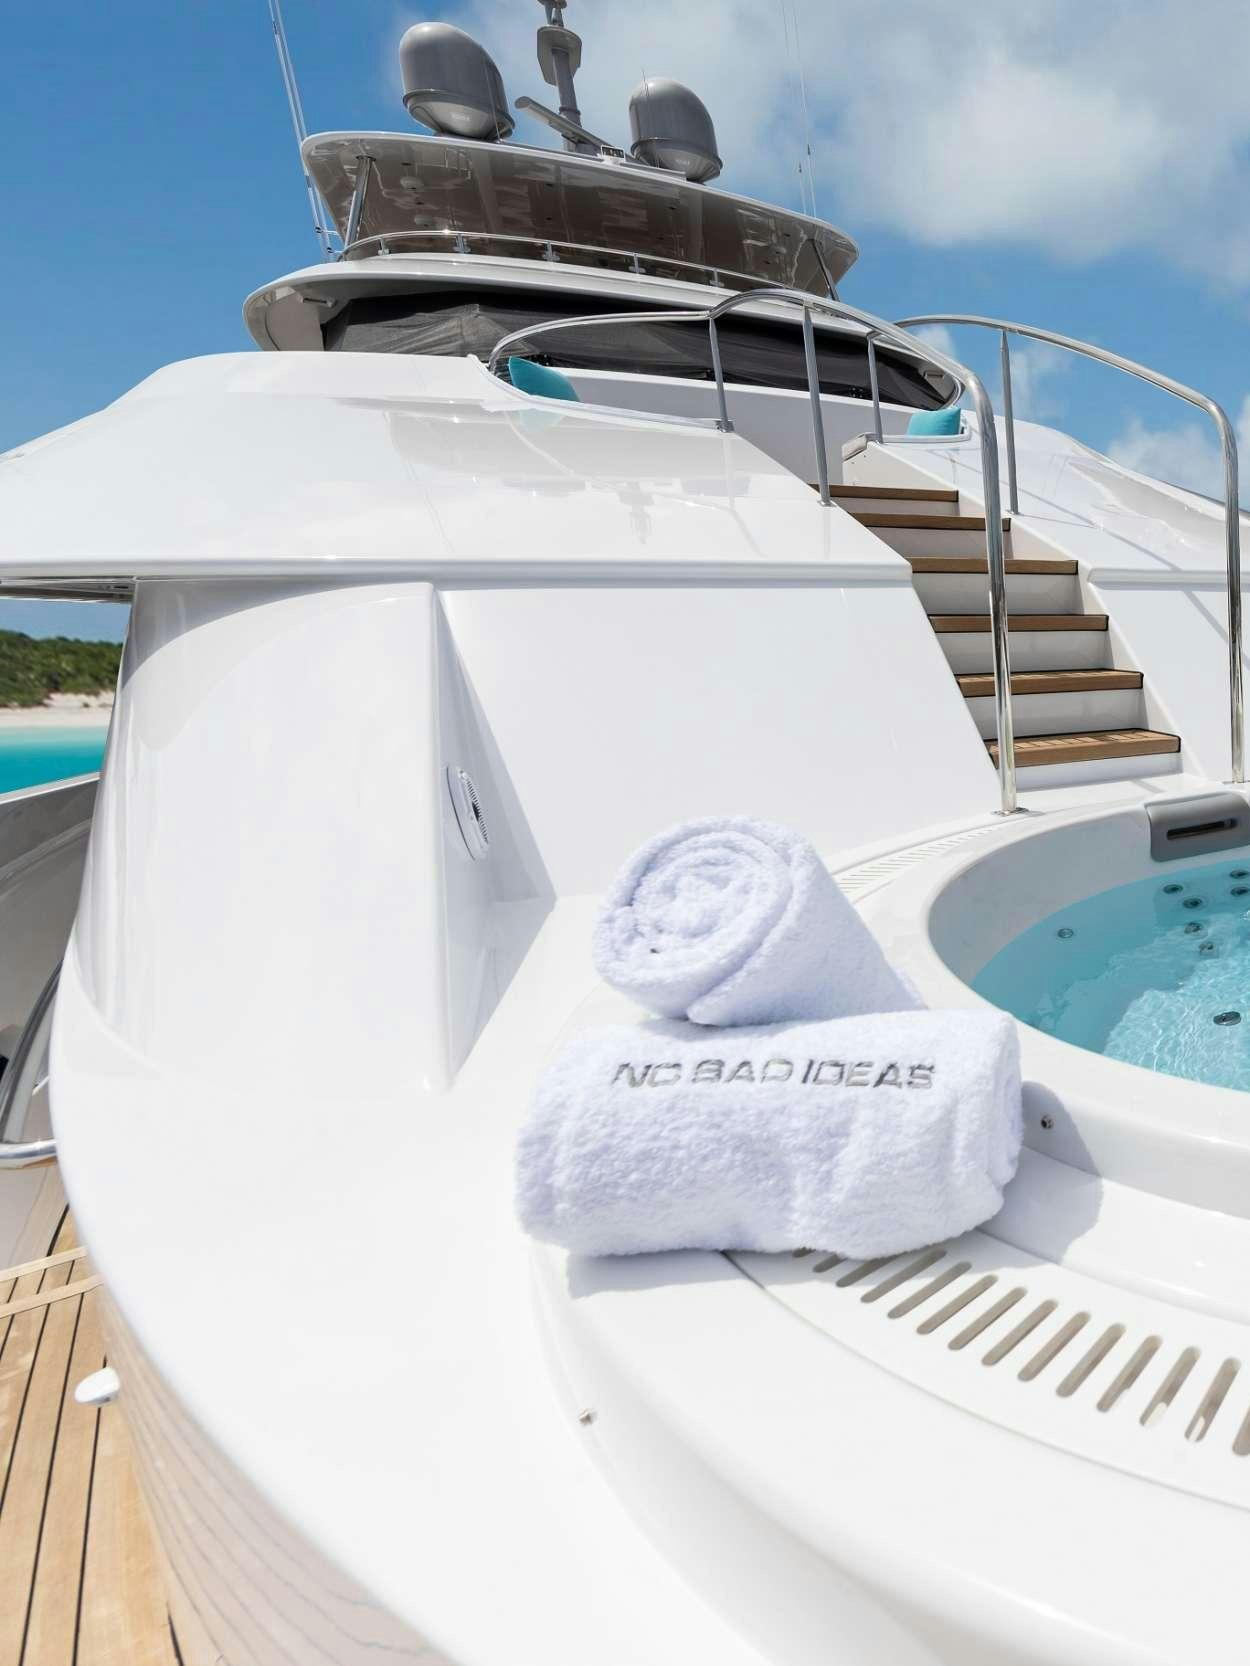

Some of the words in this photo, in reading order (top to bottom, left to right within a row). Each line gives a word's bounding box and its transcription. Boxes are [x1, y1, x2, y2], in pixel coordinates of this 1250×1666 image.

[611, 1062, 682, 1088] NO
[691, 1058, 794, 1085] BAD
[801, 1058, 936, 1089] IDEAS
